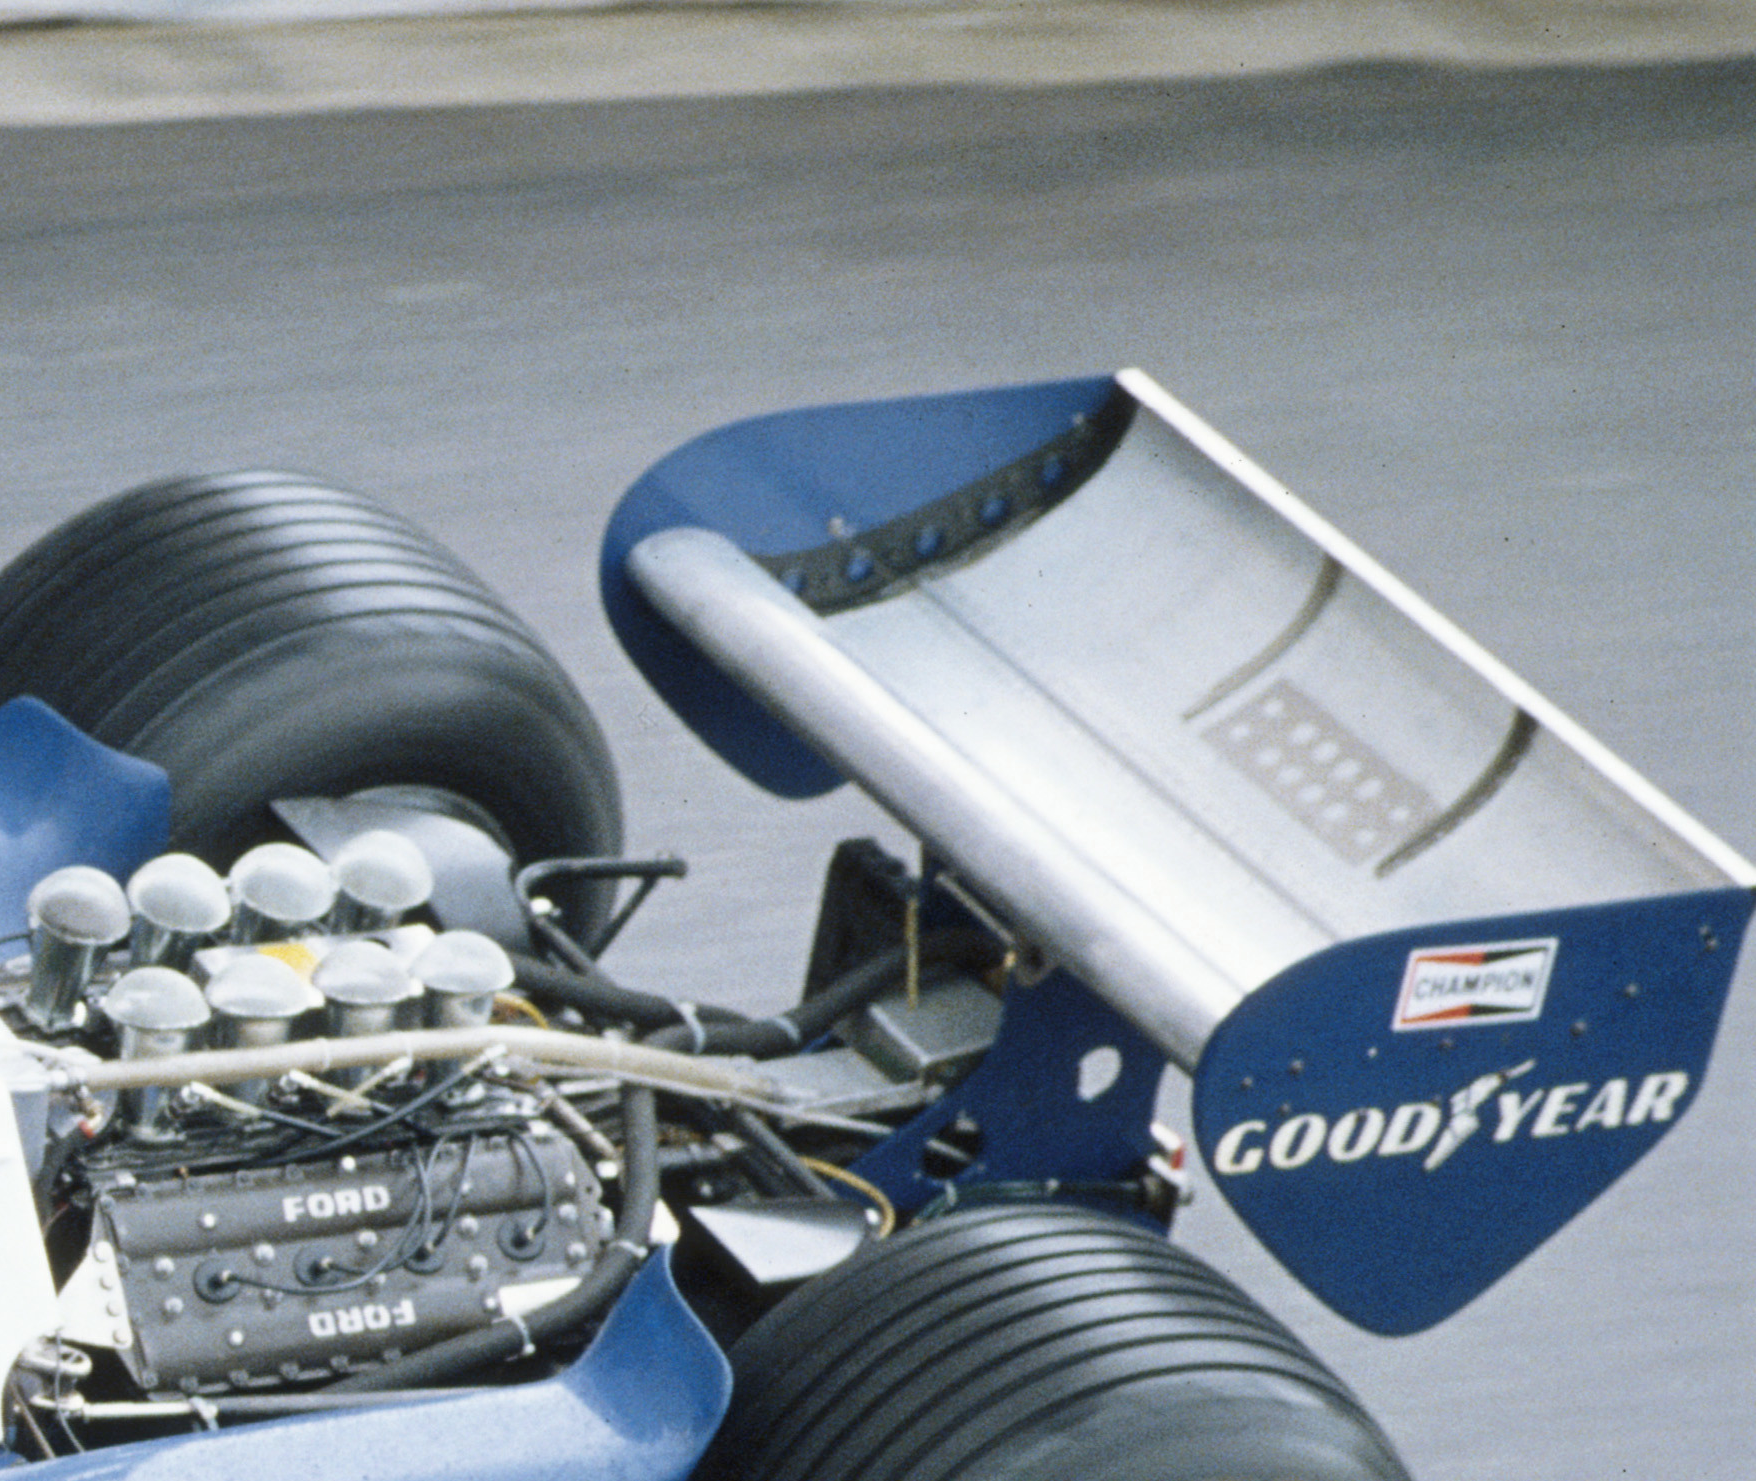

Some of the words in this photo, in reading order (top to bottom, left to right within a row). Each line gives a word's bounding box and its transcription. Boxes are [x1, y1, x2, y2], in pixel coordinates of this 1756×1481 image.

[1414, 969, 1535, 999] CHAMPION
[282, 1184, 391, 1223] FORD
[308, 1298, 417, 1339] FORD
